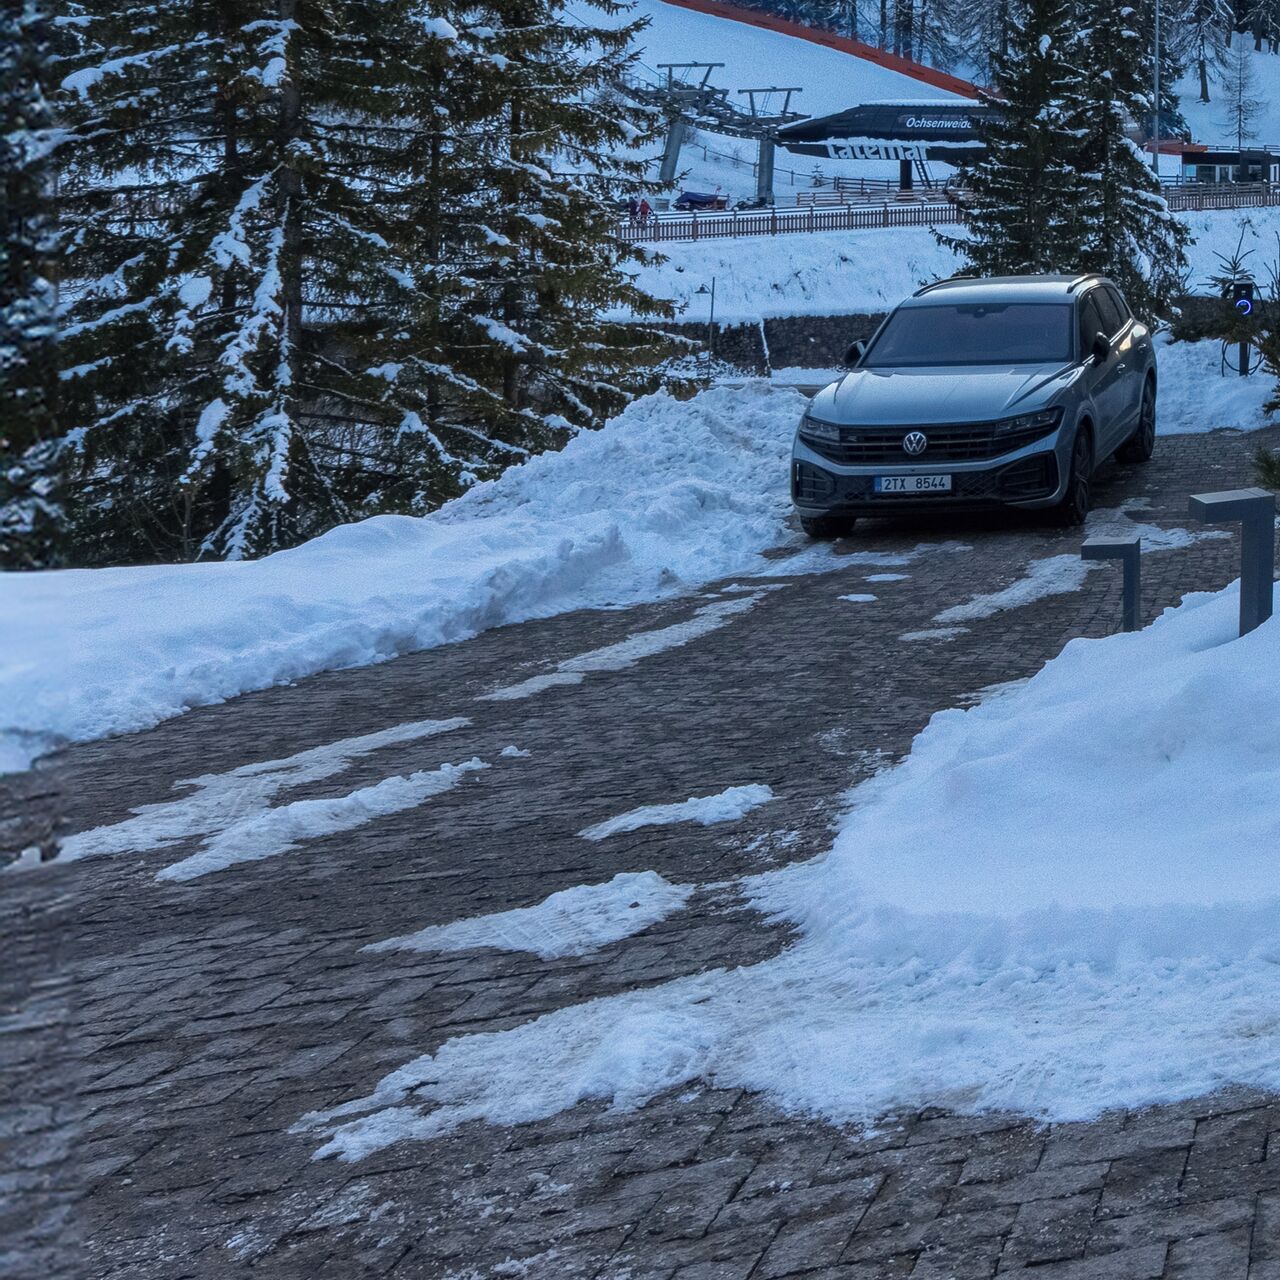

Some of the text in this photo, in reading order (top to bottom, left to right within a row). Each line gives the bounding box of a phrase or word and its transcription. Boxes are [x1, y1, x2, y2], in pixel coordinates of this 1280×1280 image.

[904, 432, 927, 455] VW
[884, 477, 946, 491] 2TX 8544
